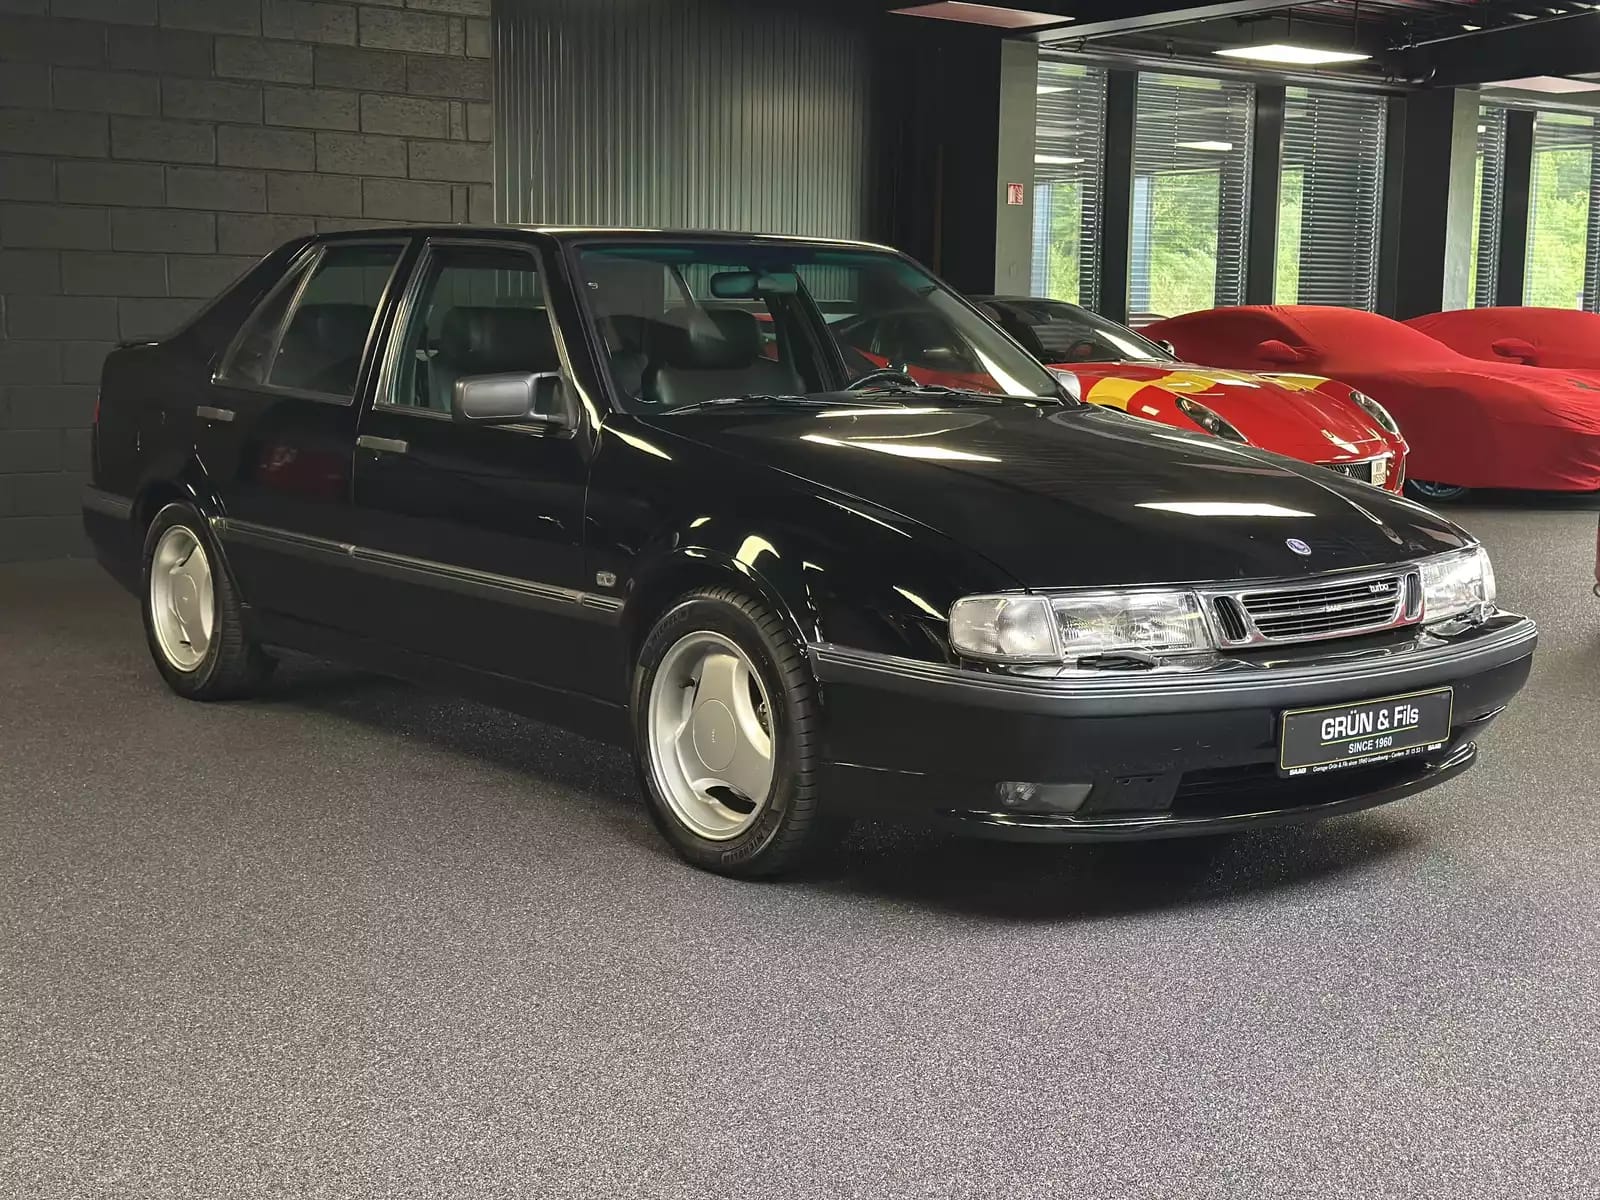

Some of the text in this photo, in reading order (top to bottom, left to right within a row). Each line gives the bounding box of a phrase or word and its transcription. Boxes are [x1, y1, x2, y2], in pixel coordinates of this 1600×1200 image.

[1369, 581, 1389, 593] turbo
[1321, 704, 1419, 740] GRÜN & Fils
[1348, 736, 1393, 754] SINCE 1960
